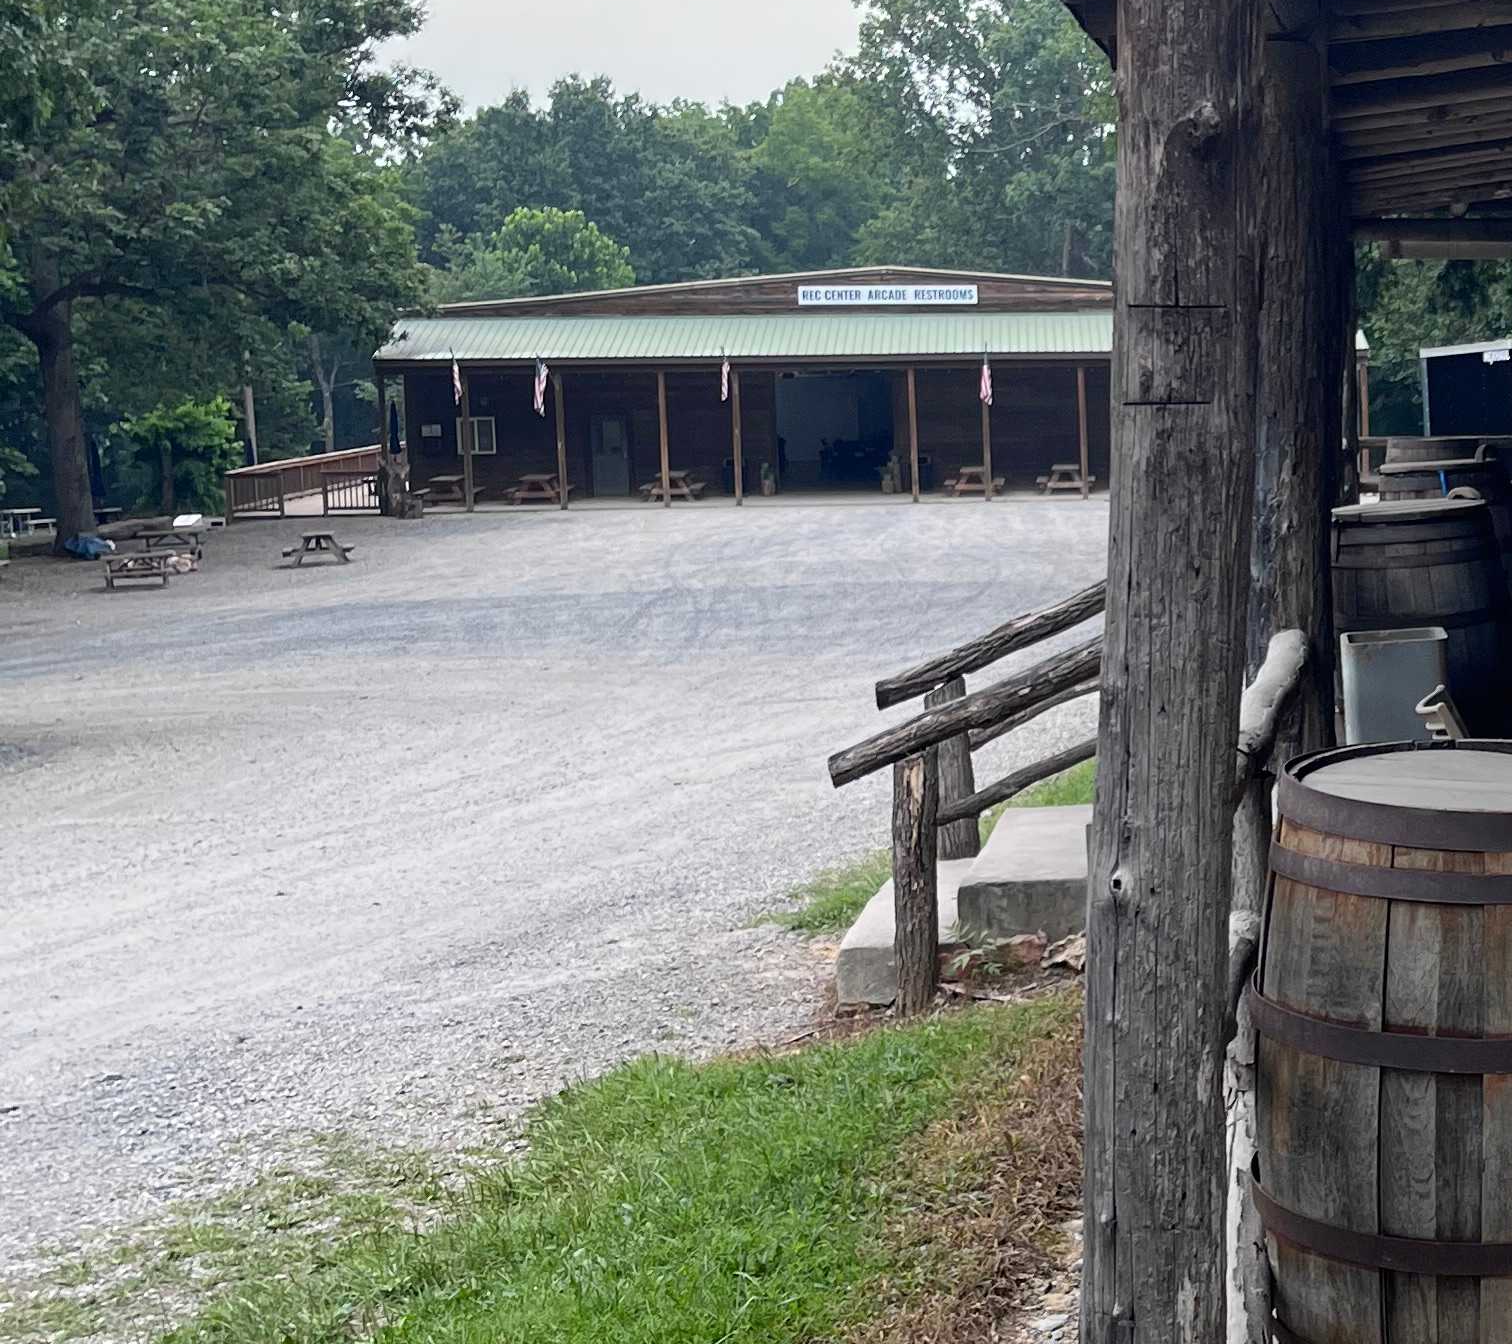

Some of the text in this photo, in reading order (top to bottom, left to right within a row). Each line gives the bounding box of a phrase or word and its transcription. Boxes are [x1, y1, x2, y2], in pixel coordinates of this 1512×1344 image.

[802, 289, 974, 301] REC CENTER ARCADE RESTROOMS
